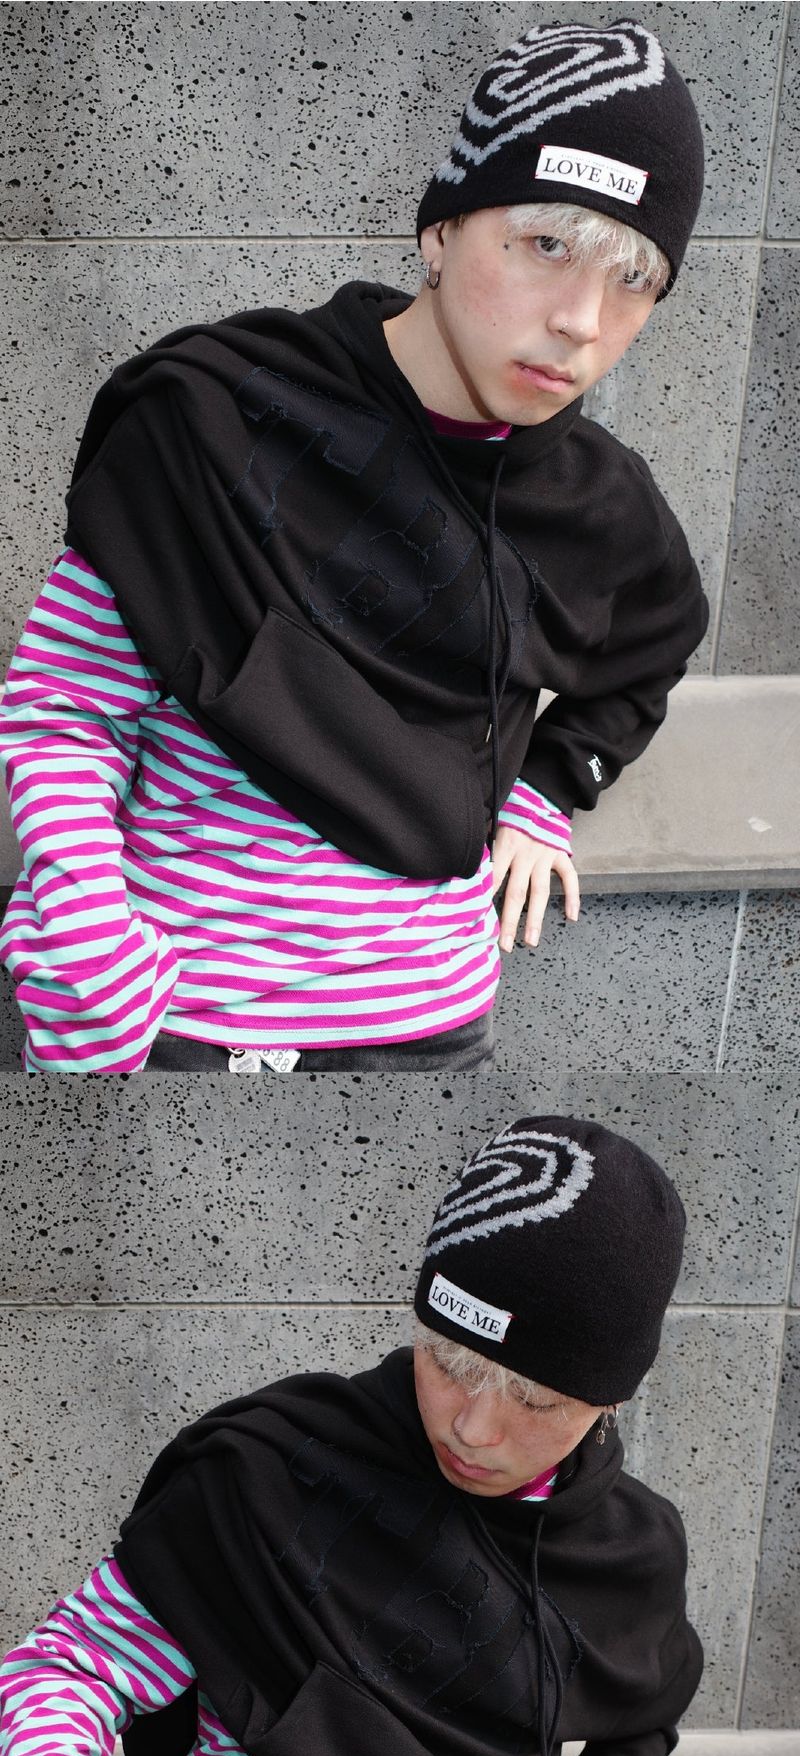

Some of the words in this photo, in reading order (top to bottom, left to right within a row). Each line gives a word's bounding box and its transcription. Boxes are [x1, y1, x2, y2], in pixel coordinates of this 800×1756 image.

[543, 158, 602, 183] LOVE
[606, 172, 638, 195] ME
[432, 1286, 470, 1320] LOVE
[471, 1311, 502, 1335] ME
